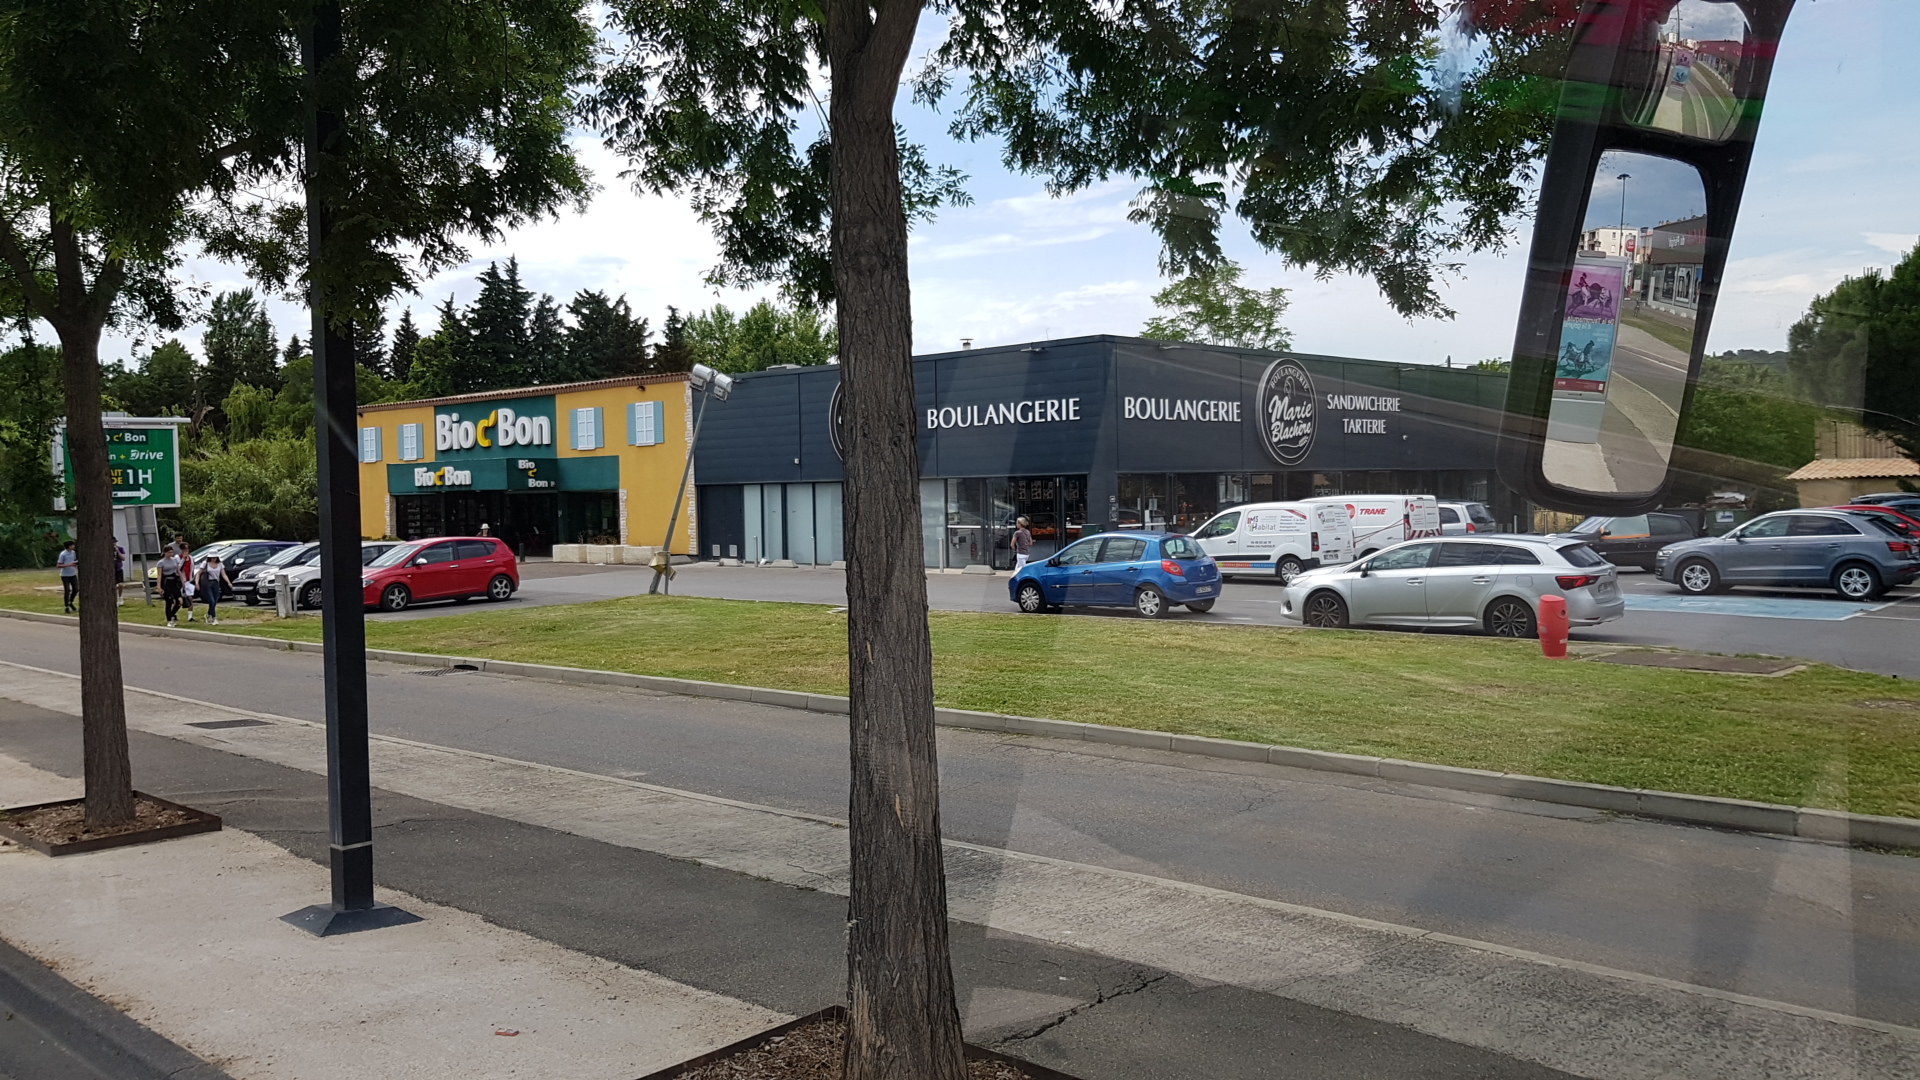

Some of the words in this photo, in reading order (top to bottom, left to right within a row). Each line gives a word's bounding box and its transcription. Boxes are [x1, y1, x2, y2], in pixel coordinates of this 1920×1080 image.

[1270, 367, 1309, 392] BOULANGERIE
[1124, 397, 1241, 422] BOULANGERIE
[1268, 395, 1312, 423] Marie
[1327, 394, 1400, 412] SANDWICHERIE
[927, 398, 1080, 429] BOULANGERIE
[436, 413, 476, 450] Bio
[498, 408, 551, 446] Bon
[1271, 420, 1311, 442] Blachère
[1342, 418, 1386, 434] TARTERIE
[125, 433, 146, 442] Bon
[130, 449, 164, 460] Drive
[518, 460, 535, 469] Bio
[414, 467, 435, 486] Bio
[445, 466, 471, 485] Bon
[528, 478, 548, 487] Bon
[1250, 523, 1276, 531] Habitat
